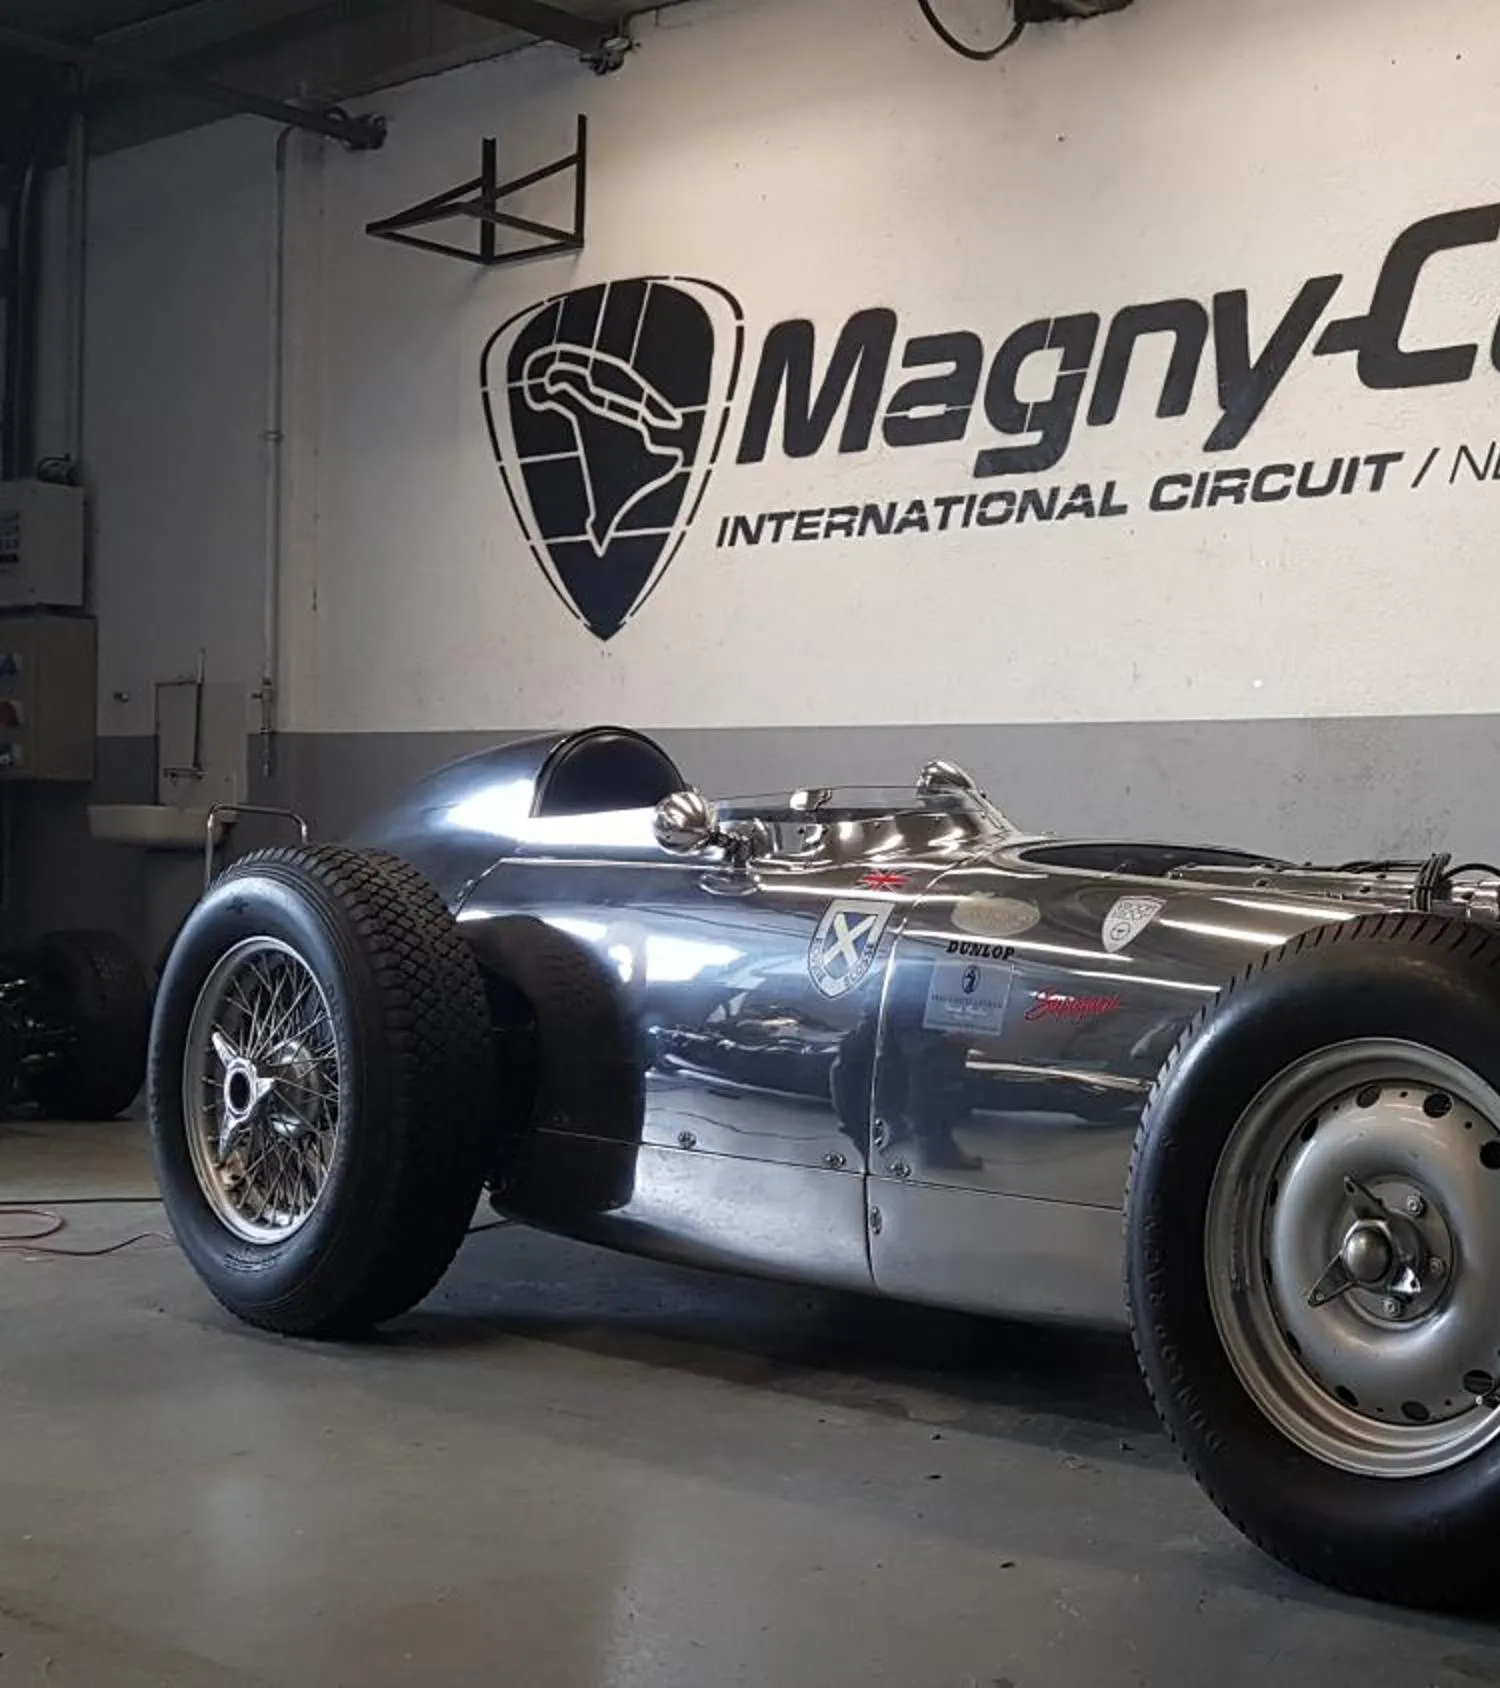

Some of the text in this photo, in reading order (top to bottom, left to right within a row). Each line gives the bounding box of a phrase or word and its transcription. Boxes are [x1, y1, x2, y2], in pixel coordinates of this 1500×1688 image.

[716, 481, 1128, 548] INTERNATIONAL
[1148, 452, 1404, 511] CIRCUIT
[945, 940, 1016, 960] DUNLOP
